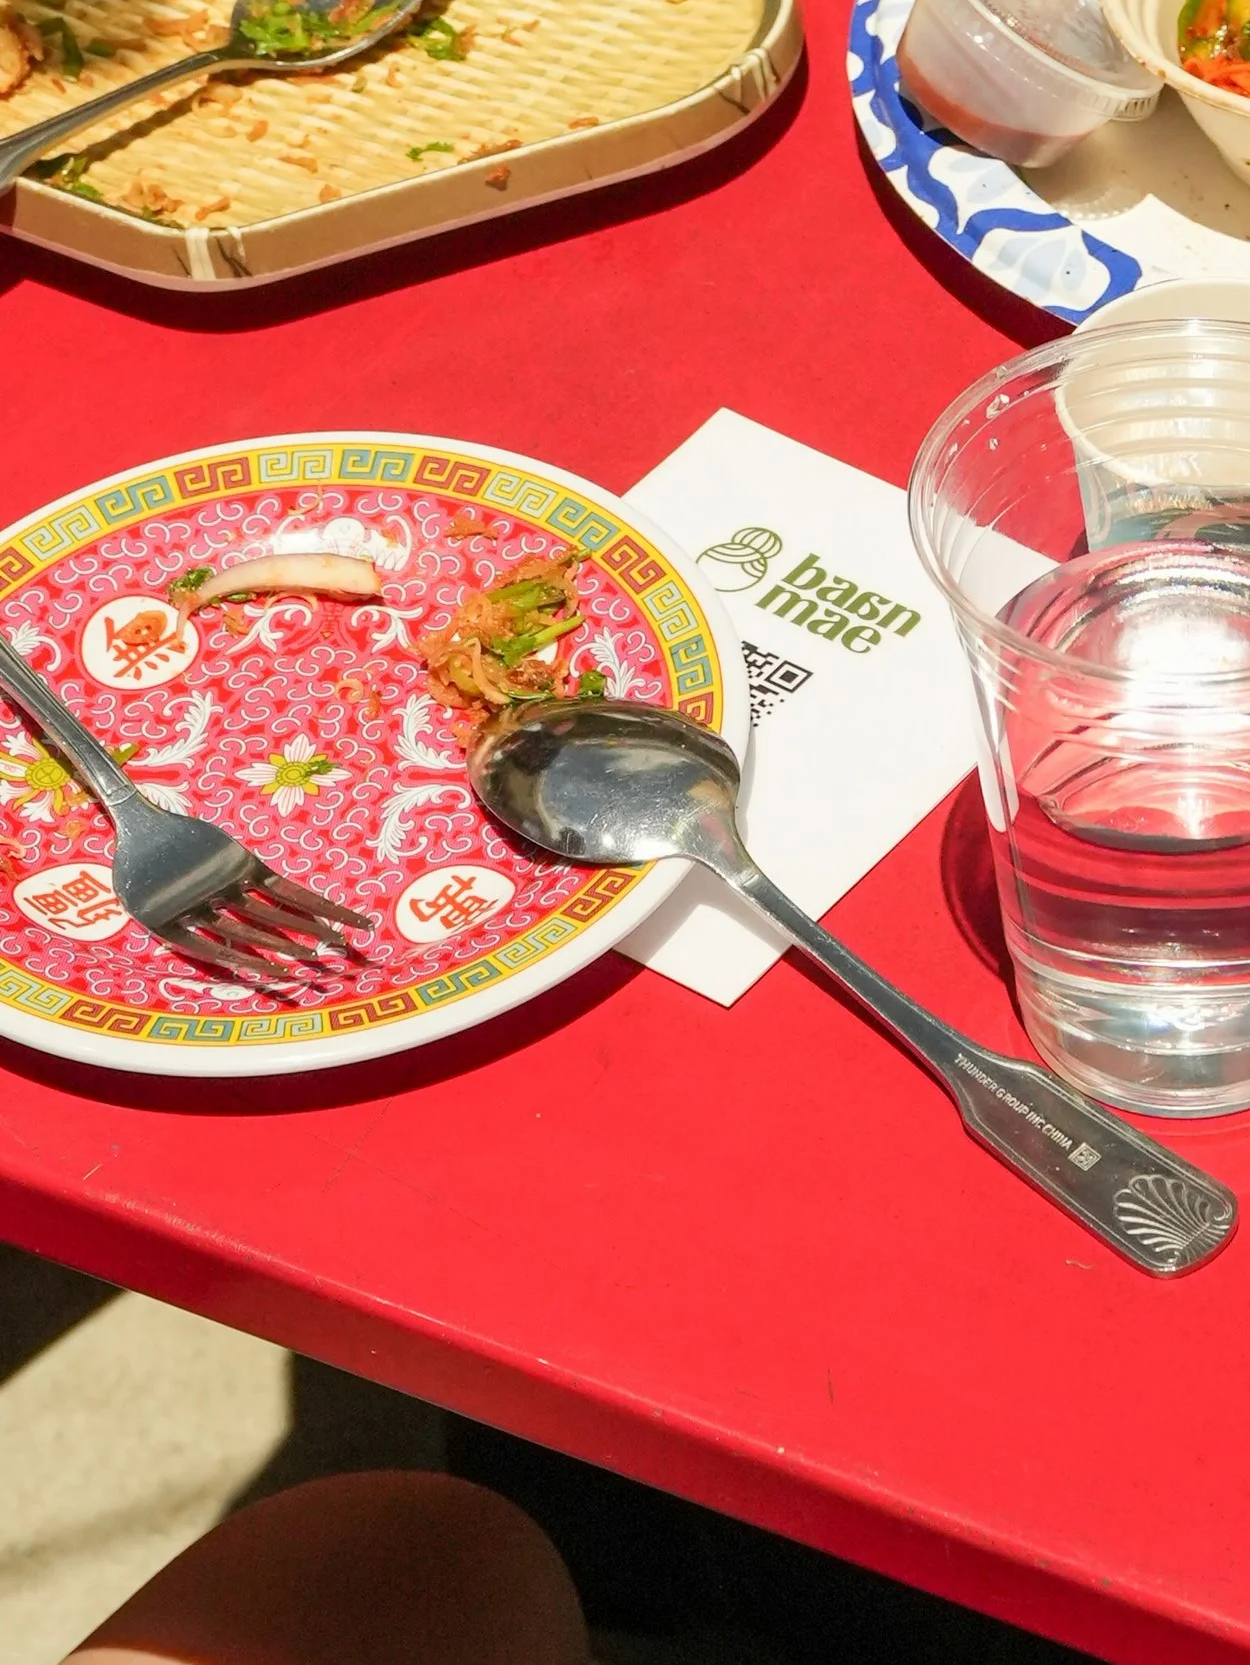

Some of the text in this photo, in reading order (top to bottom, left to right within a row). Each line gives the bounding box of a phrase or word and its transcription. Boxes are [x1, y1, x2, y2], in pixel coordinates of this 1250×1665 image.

[754, 584, 882, 654] mae
[954, 1053, 998, 1093] THUNDER
[996, 1086, 1030, 1116] GROUP
[1041, 1122, 1073, 1151] CHINA
